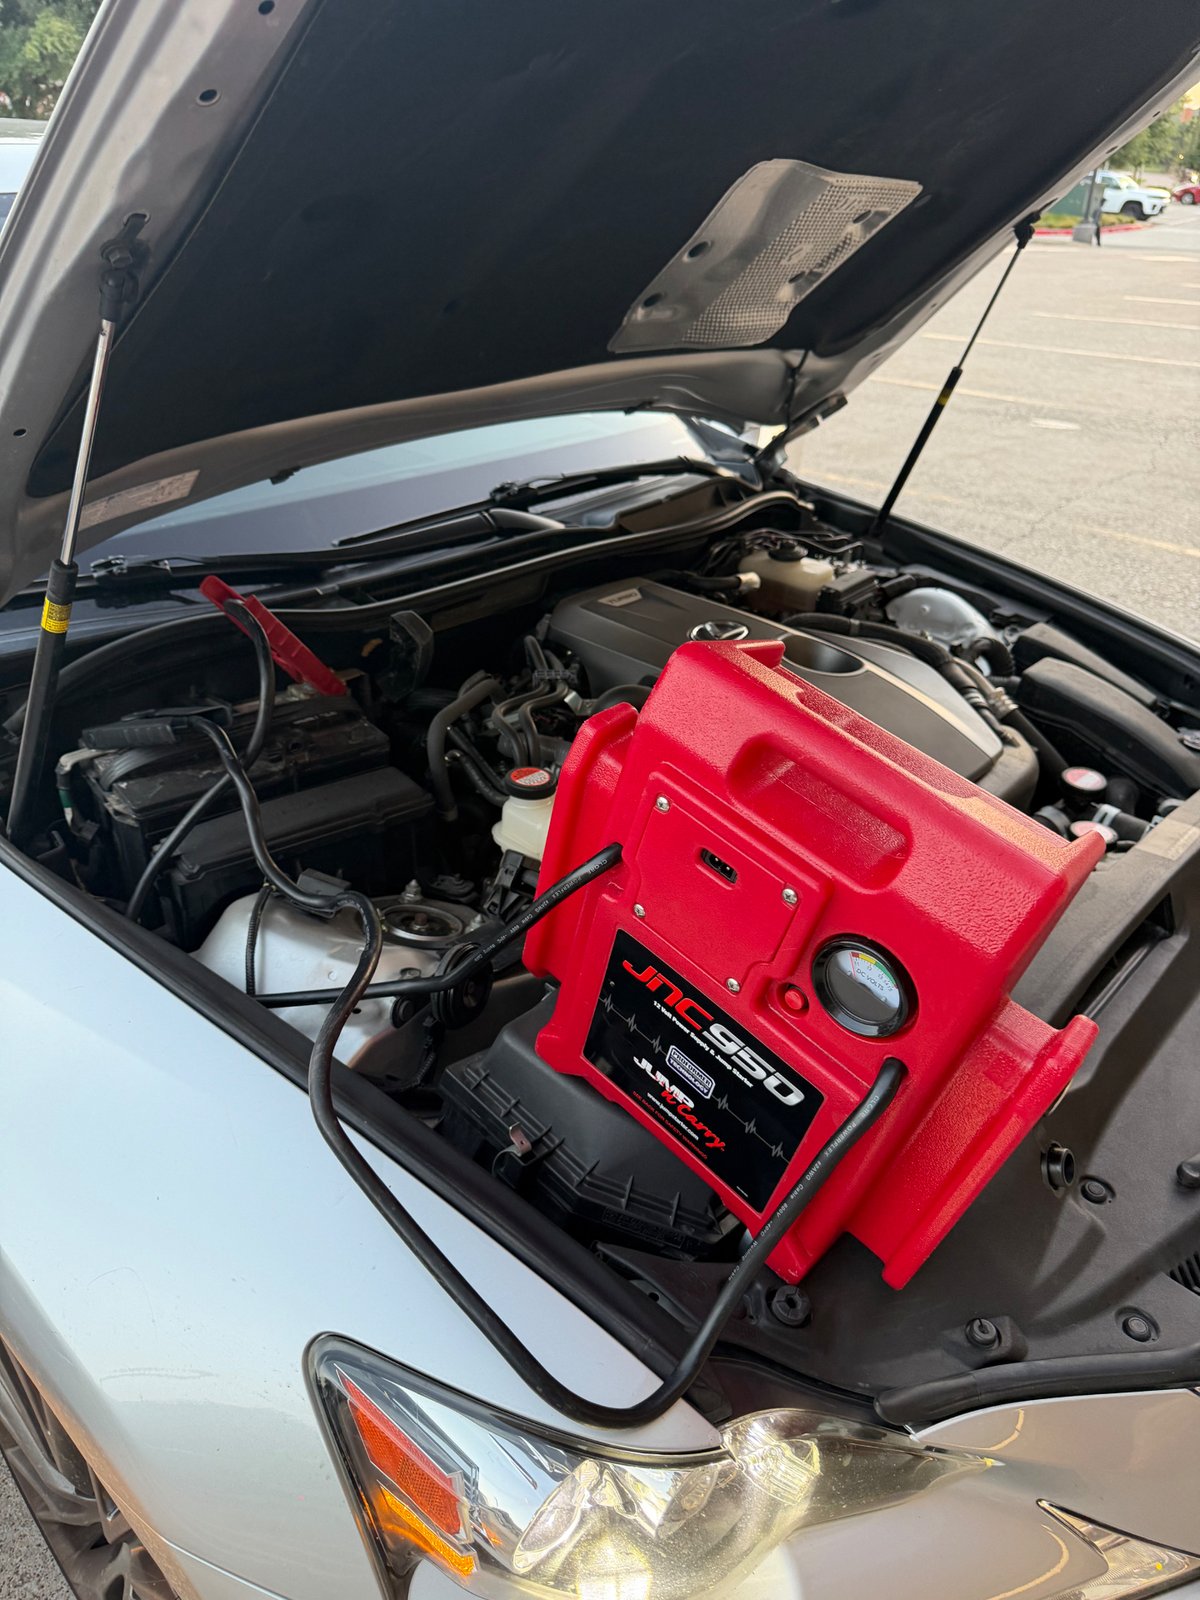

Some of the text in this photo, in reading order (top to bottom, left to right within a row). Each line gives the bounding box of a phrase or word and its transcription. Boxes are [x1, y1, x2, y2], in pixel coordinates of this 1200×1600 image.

[856, 968, 884, 991] DC VOLTS
[654, 1001, 661, 1009] 12
[661, 1007, 672, 1019] Volt
[672, 1016, 690, 1033] Power
[690, 1032, 710, 1051] Supply
[715, 1055, 732, 1070] Jump
[732, 1068, 753, 1087] Starter
[668, 1058, 708, 1093] TECHNOLOGY
[671, 1050, 711, 1087] PROFORMER
[633, 1056, 694, 1109] JUMP
[677, 1103, 725, 1149] Carry
[647, 1093, 699, 1140] www.jumpstarter.com
[825, 1122, 857, 1156] POWERFLEX
